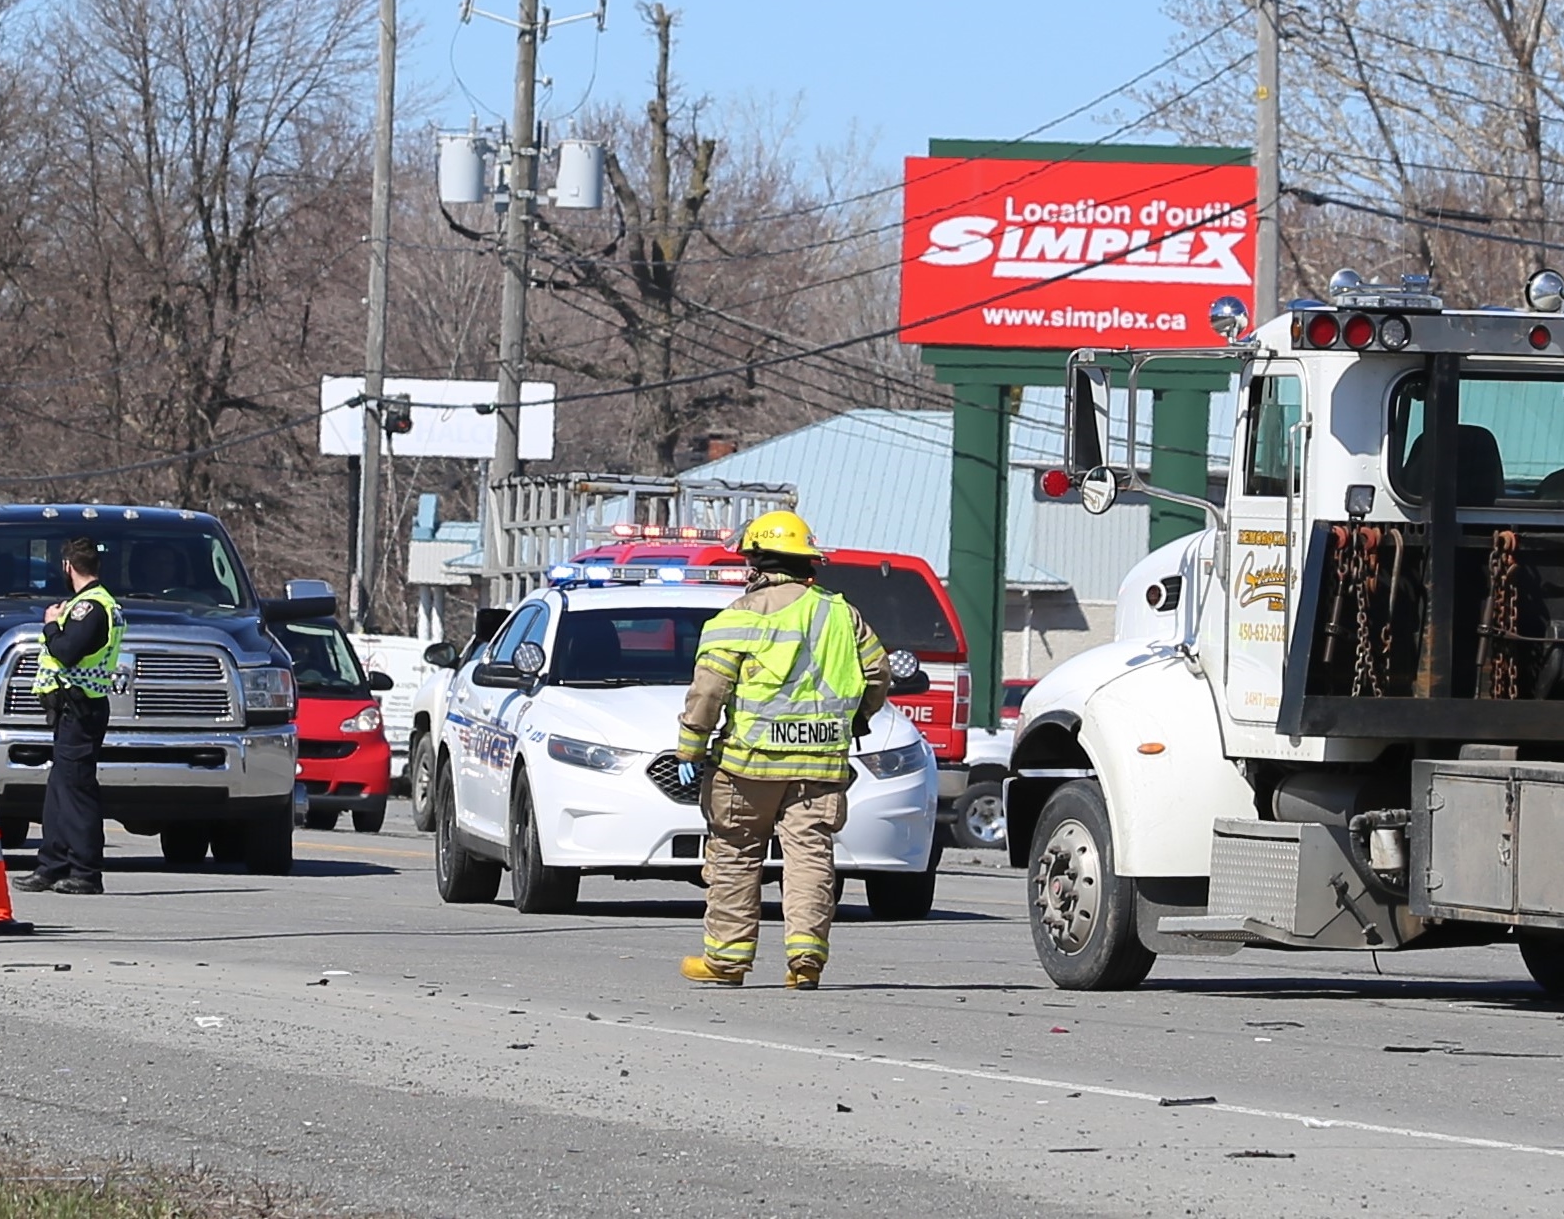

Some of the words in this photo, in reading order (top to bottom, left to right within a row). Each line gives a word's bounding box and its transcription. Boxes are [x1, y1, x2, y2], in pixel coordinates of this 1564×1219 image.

[1005, 196, 1131, 226] Location
[1139, 199, 1248, 229] d'outils
[918, 214, 1252, 286] SIMPLEX
[982, 306, 1187, 333] www.simplex.ca
[897, 705, 933, 723] DIE
[771, 721, 839, 744] INCENDIE
